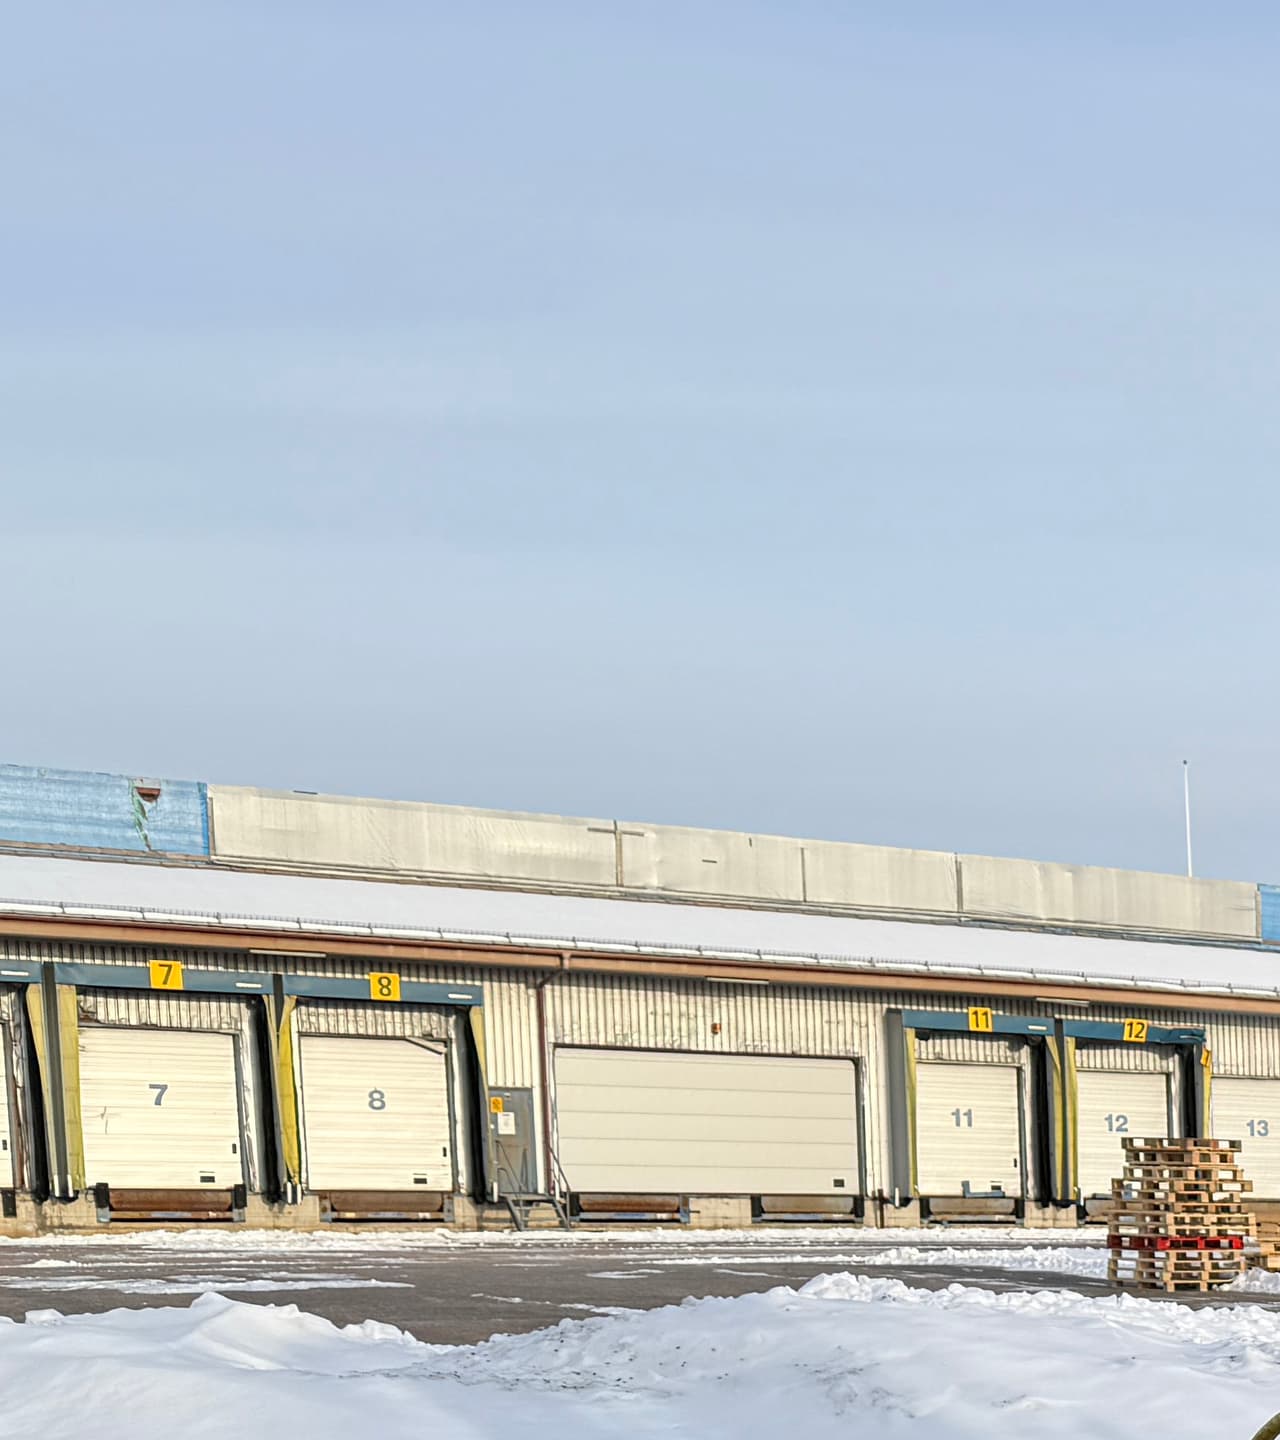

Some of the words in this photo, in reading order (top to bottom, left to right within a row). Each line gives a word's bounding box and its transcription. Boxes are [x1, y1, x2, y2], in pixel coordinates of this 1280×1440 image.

[157, 963, 175, 986] 7
[378, 975, 392, 997] 8
[970, 1010, 990, 1029] 11
[1126, 1021, 1146, 1040] 12
[148, 1083, 168, 1106] 7
[367, 1088, 386, 1110] 8
[951, 1108, 973, 1128] 11
[1104, 1113, 1129, 1133] 12
[1246, 1119, 1270, 1138] 13
